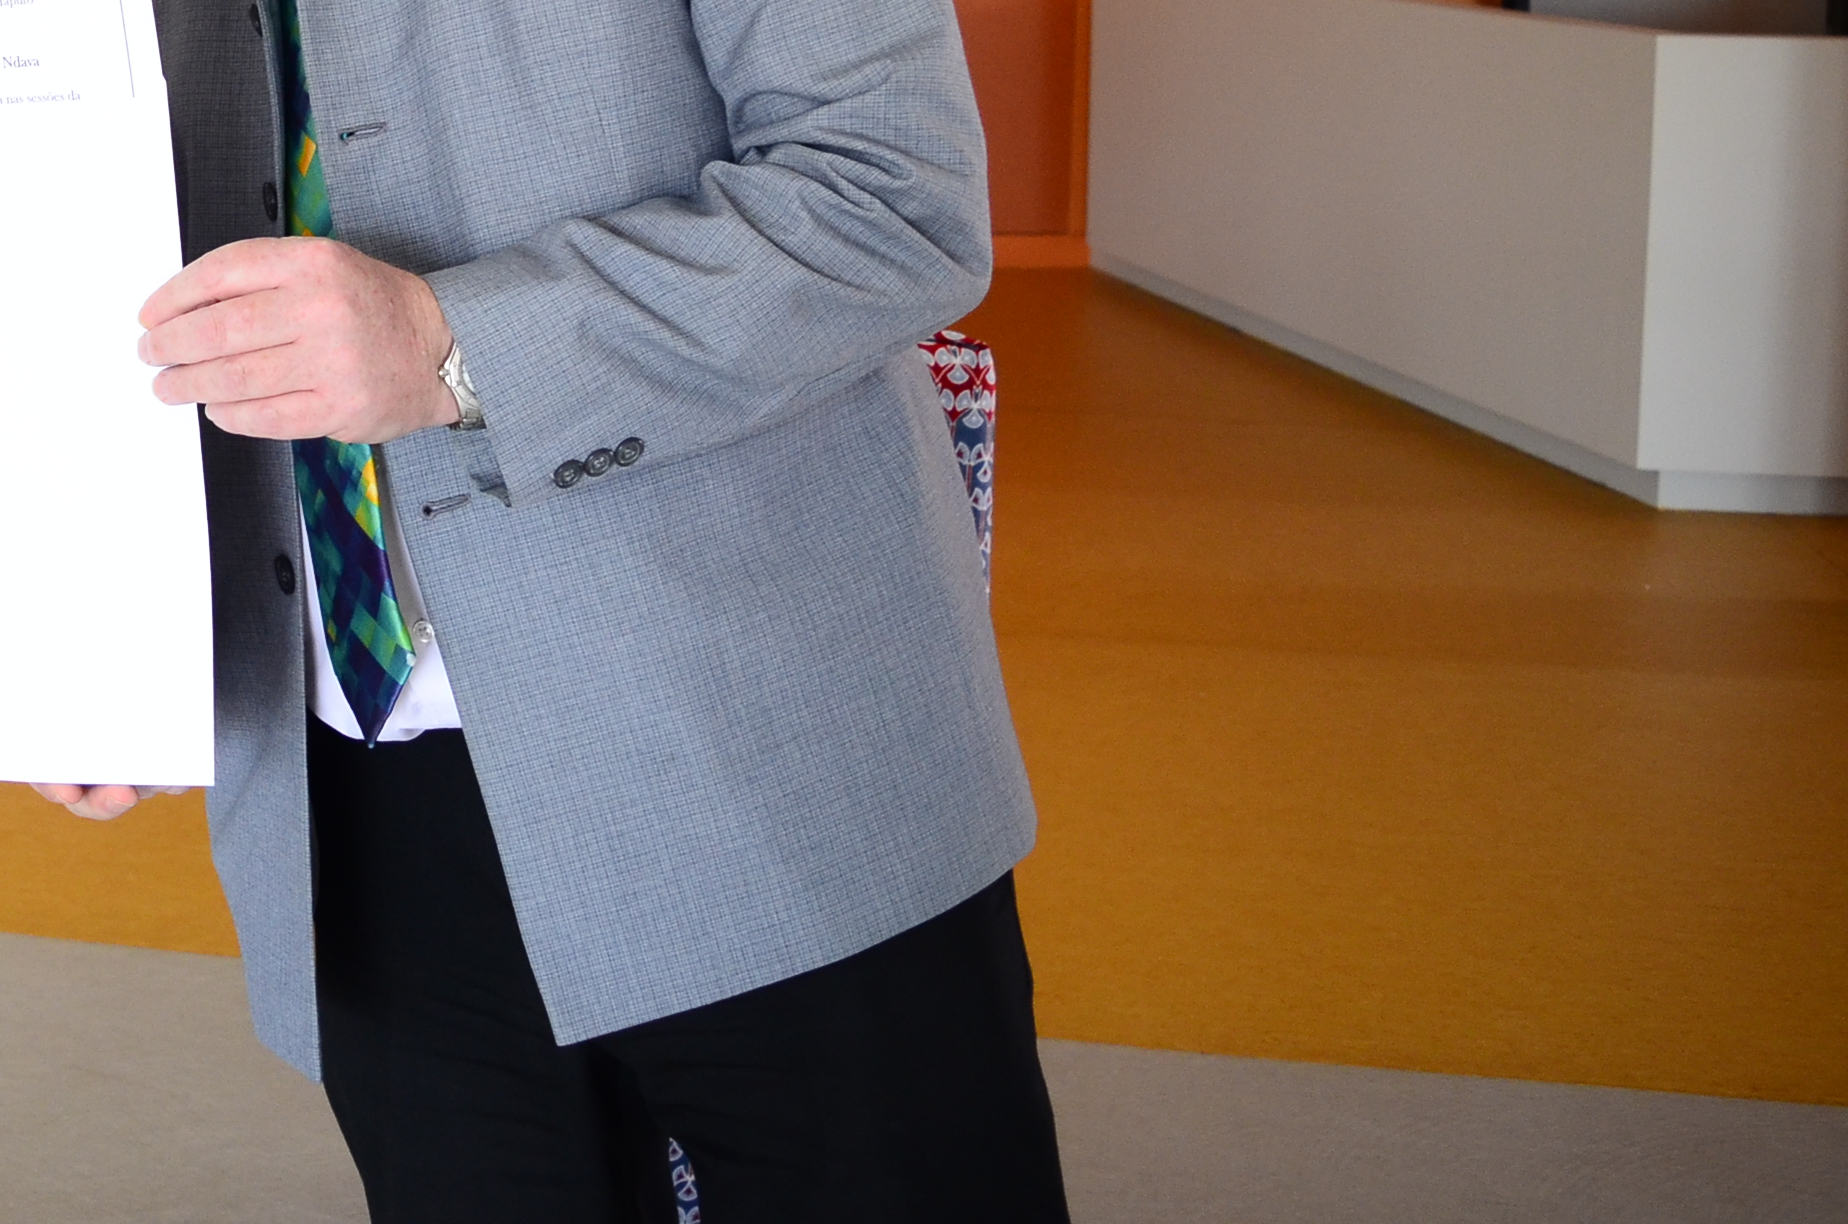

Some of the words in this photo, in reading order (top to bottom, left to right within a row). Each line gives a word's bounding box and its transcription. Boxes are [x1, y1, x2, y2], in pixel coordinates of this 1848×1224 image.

[2, 55, 40, 69] Ndava
[6, 96, 24, 105] nas
[26, 91, 65, 103] sessões
[67, 89, 81, 101] da
